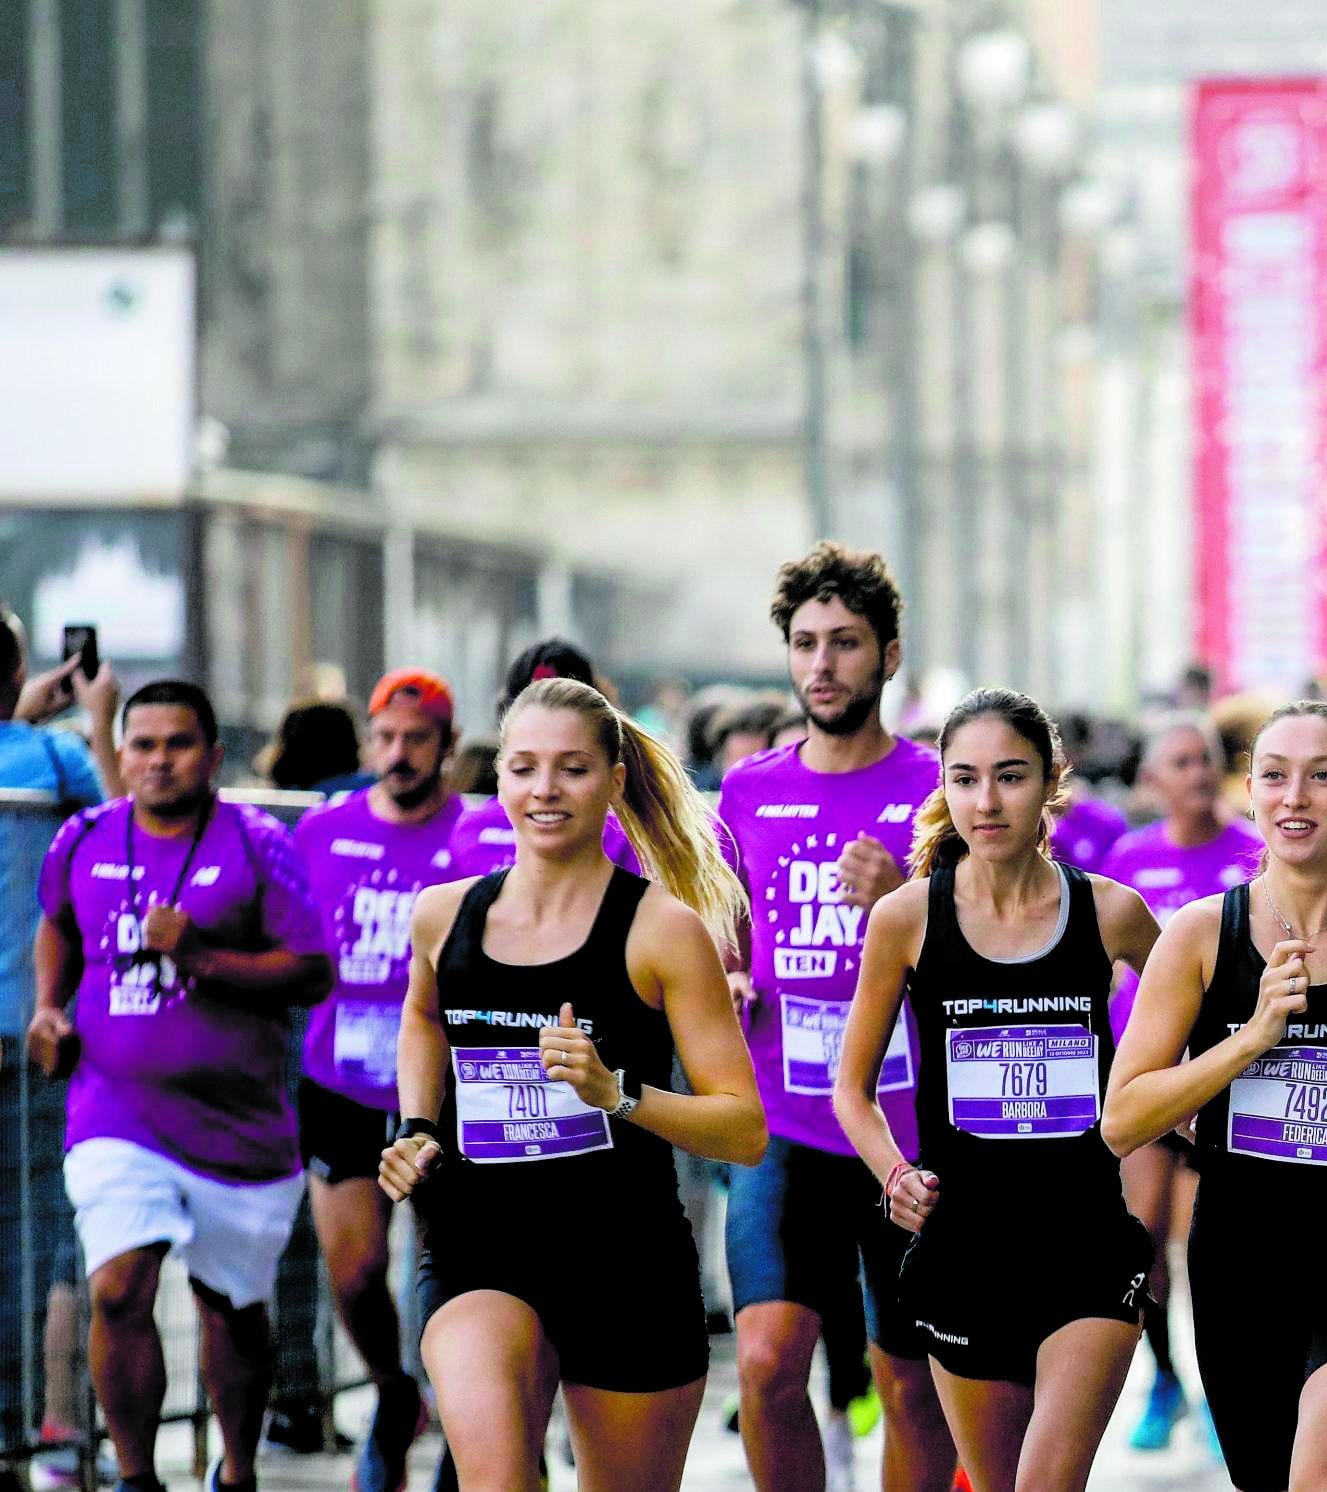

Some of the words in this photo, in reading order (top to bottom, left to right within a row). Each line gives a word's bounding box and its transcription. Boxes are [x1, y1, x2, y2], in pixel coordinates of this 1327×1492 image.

[789, 860, 848, 905] DE
[790, 904, 865, 947] JAY
[783, 954, 827, 972] TEN
[942, 997, 1091, 1015] TOP4RUNNING
[445, 1009, 593, 1035] TOP4RUNNIG
[977, 1041, 1001, 1058] WE
[1002, 1041, 1023, 1058] RUN
[1022, 1045, 1044, 1058] DEEJAY
[479, 1063, 503, 1079] WE
[502, 1064, 519, 1079] RUN
[999, 1063, 1047, 1097] 7679
[1263, 1062, 1291, 1077] WE
[1291, 1062, 1312, 1081] RUN
[503, 1085, 549, 1118] 7401
[1002, 1101, 1047, 1118] BARBORA
[503, 1121, 560, 1142] FRANCESCA
